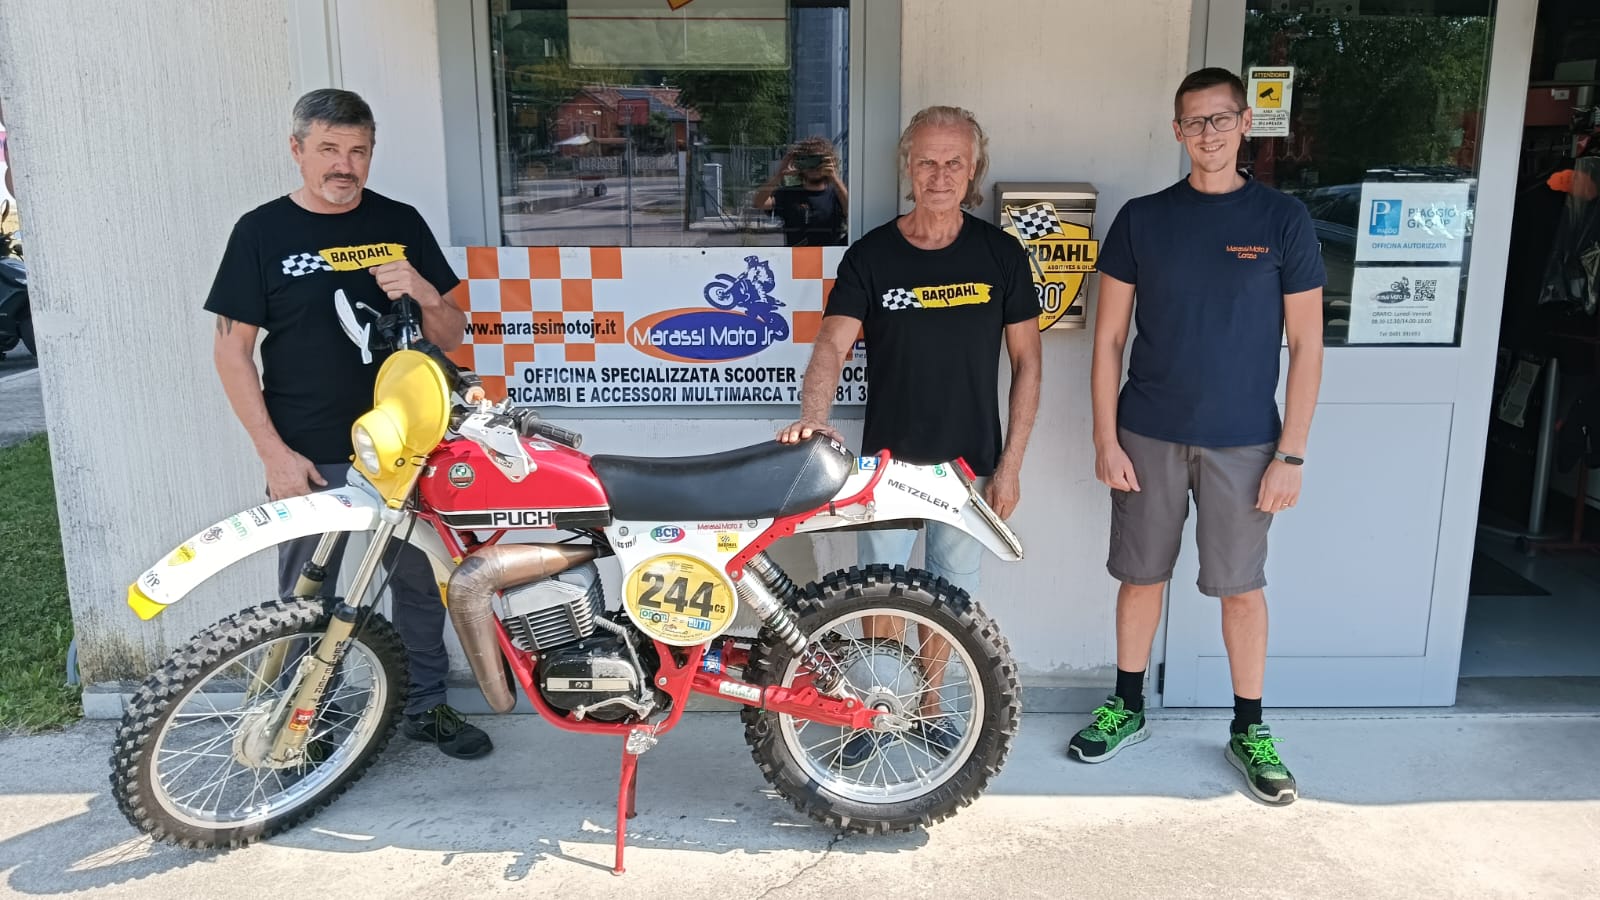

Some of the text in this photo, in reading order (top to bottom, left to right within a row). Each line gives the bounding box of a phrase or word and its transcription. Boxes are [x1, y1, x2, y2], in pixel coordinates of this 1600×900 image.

[330, 245, 393, 266] BARDAHL
[1026, 244, 1095, 262] RDAHL
[921, 284, 979, 306] BARDAHL
[465, 319, 617, 338] ww.marassimotojr.it
[633, 326, 774, 346] Marassi Moto Jr
[524, 367, 598, 384] OFFICINA
[601, 367, 720, 383] SPECIALIZZATA
[724, 367, 797, 383] SCOOTER
[507, 387, 571, 403] RICAMBI
[576, 387, 586, 402] E
[590, 386, 678, 403] ACCESSORI
[682, 386, 783, 402] MULTIMARCA
[887, 478, 950, 511] METZELER
[493, 511, 551, 526] PUCH
[655, 527, 680, 538] BCR
[638, 571, 726, 618] 244 C5
